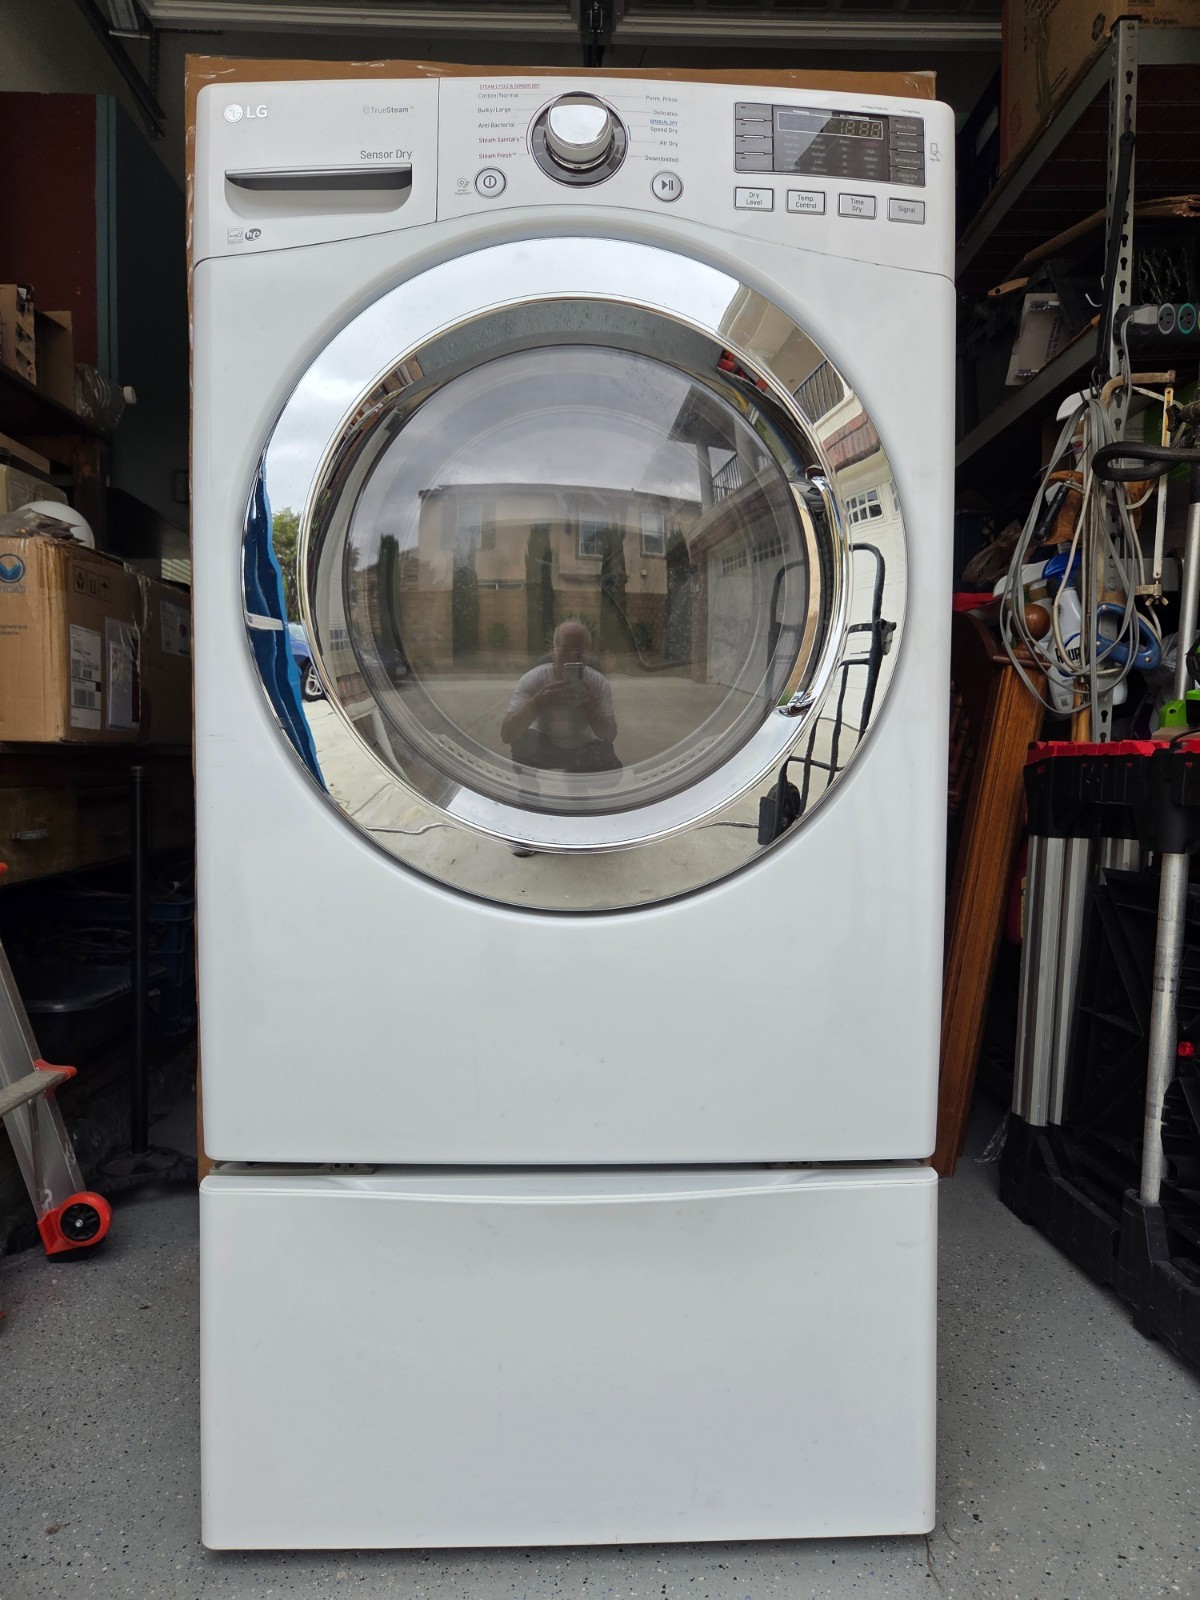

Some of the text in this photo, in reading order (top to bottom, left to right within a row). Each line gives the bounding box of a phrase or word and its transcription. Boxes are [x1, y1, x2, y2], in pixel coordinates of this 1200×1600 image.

[246, 105, 269, 119] LG
[652, 109, 678, 117] Delicates
[360, 149, 413, 160] Sensor Dry
[645, 155, 679, 163] Downloaded
[748, 192, 760, 200] Dry
[797, 195, 814, 203] Temp
[795, 201, 817, 209] Control
[850, 198, 865, 206] Time
[851, 205, 863, 213] Dry
[897, 206, 916, 214] Signal
